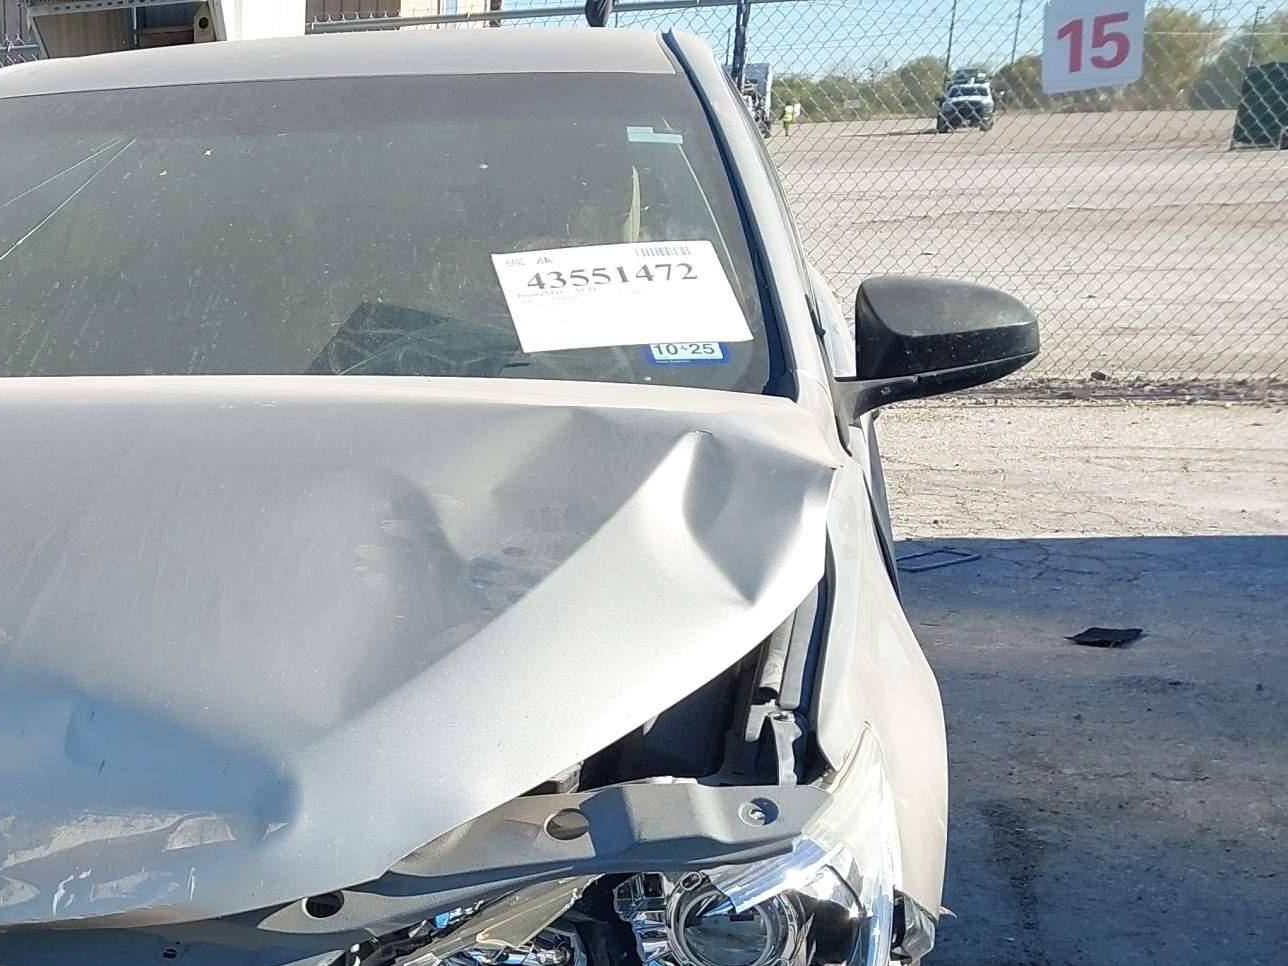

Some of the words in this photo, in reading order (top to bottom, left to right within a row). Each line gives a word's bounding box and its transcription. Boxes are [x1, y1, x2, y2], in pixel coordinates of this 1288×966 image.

[1056, 11, 1130, 73] 15
[527, 262, 699, 290] 43551472
[688, 343, 716, 355] 25
